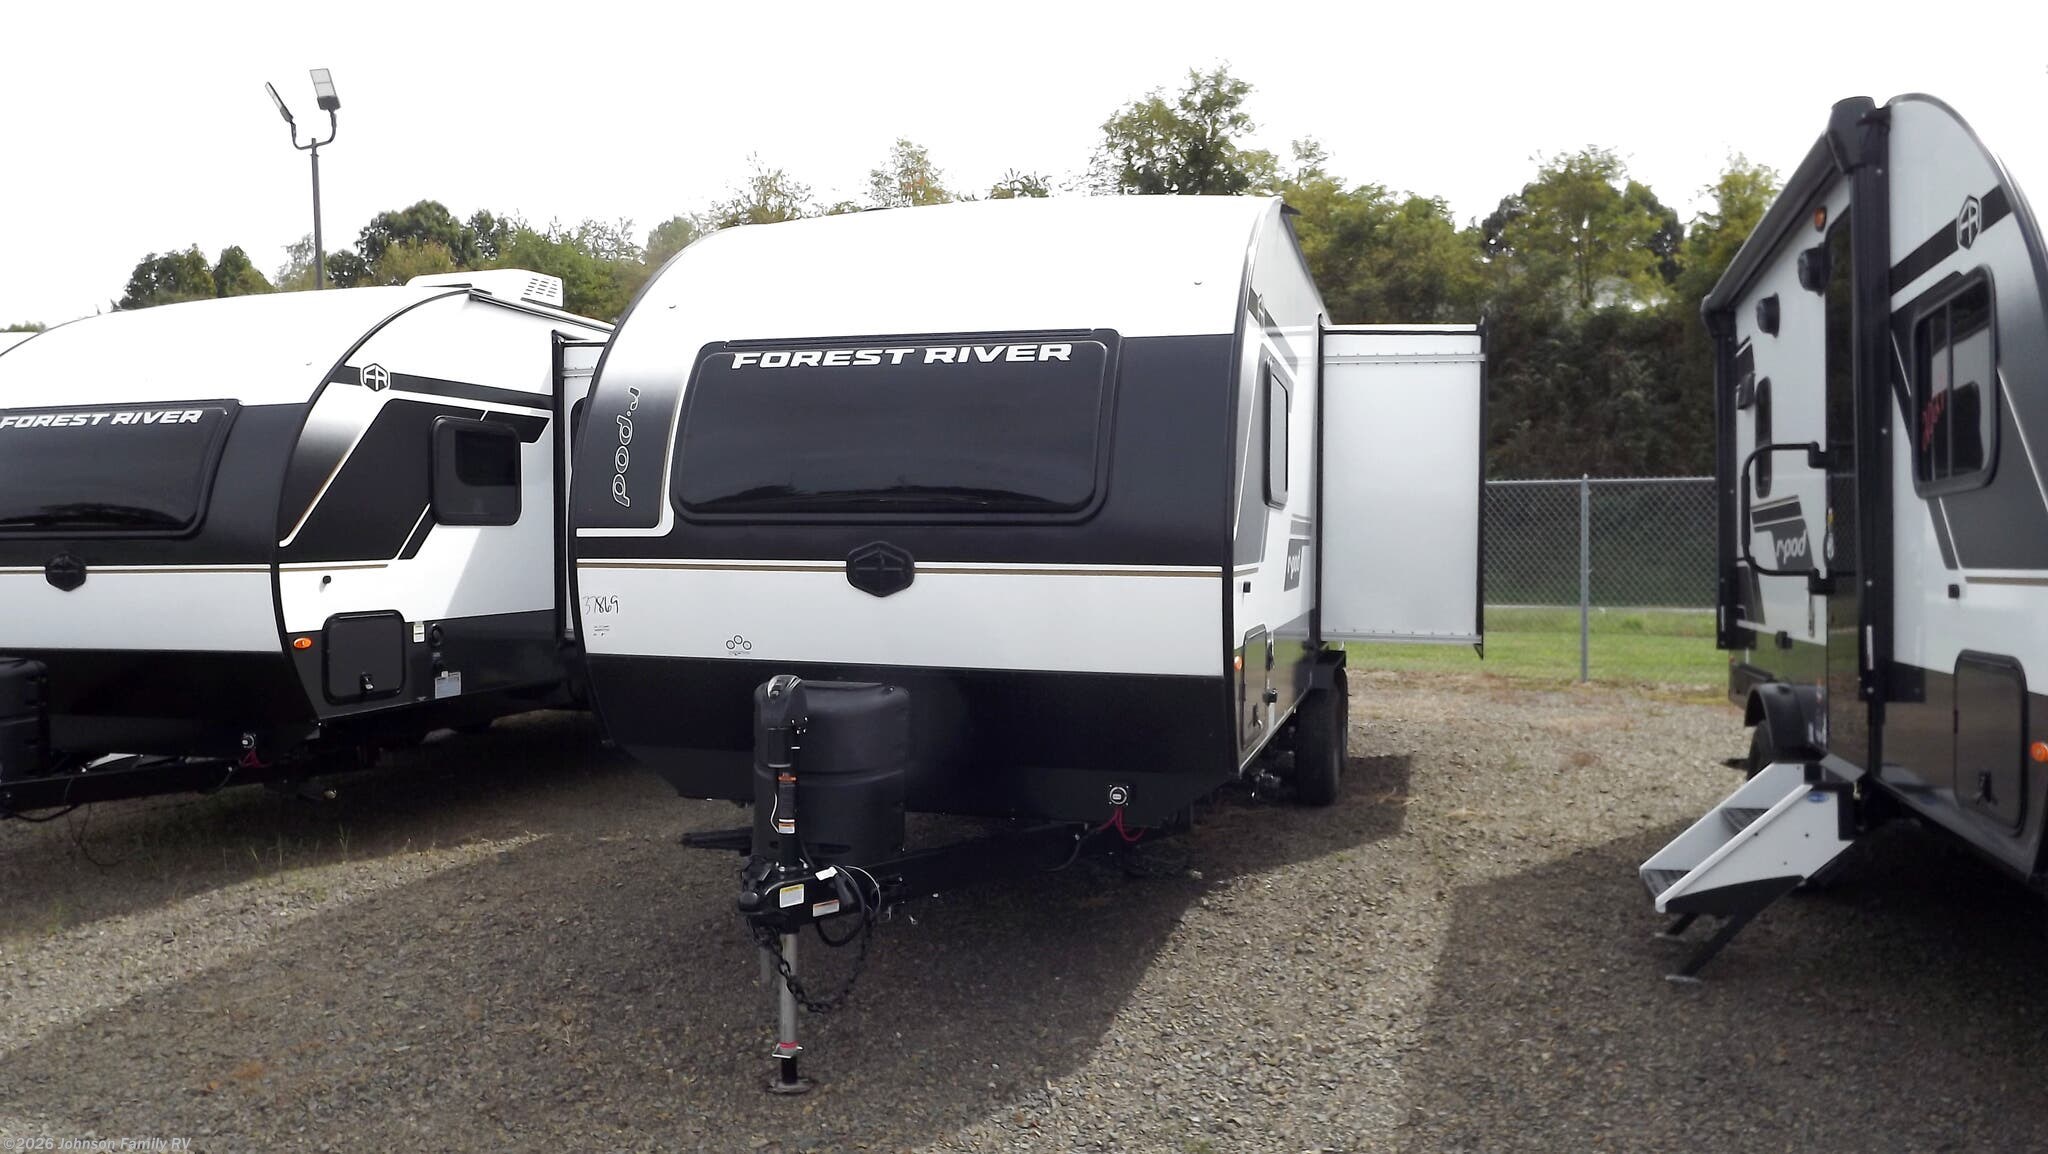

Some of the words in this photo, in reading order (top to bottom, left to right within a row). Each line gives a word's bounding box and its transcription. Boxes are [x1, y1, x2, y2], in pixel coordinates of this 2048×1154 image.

[731, 348, 915, 369] FOREST
[924, 344, 1073, 364] RIVER
[0, 412, 110, 429] FOREST
[110, 409, 204, 425] RIVER
[583, 595, 619, 615] 37869
